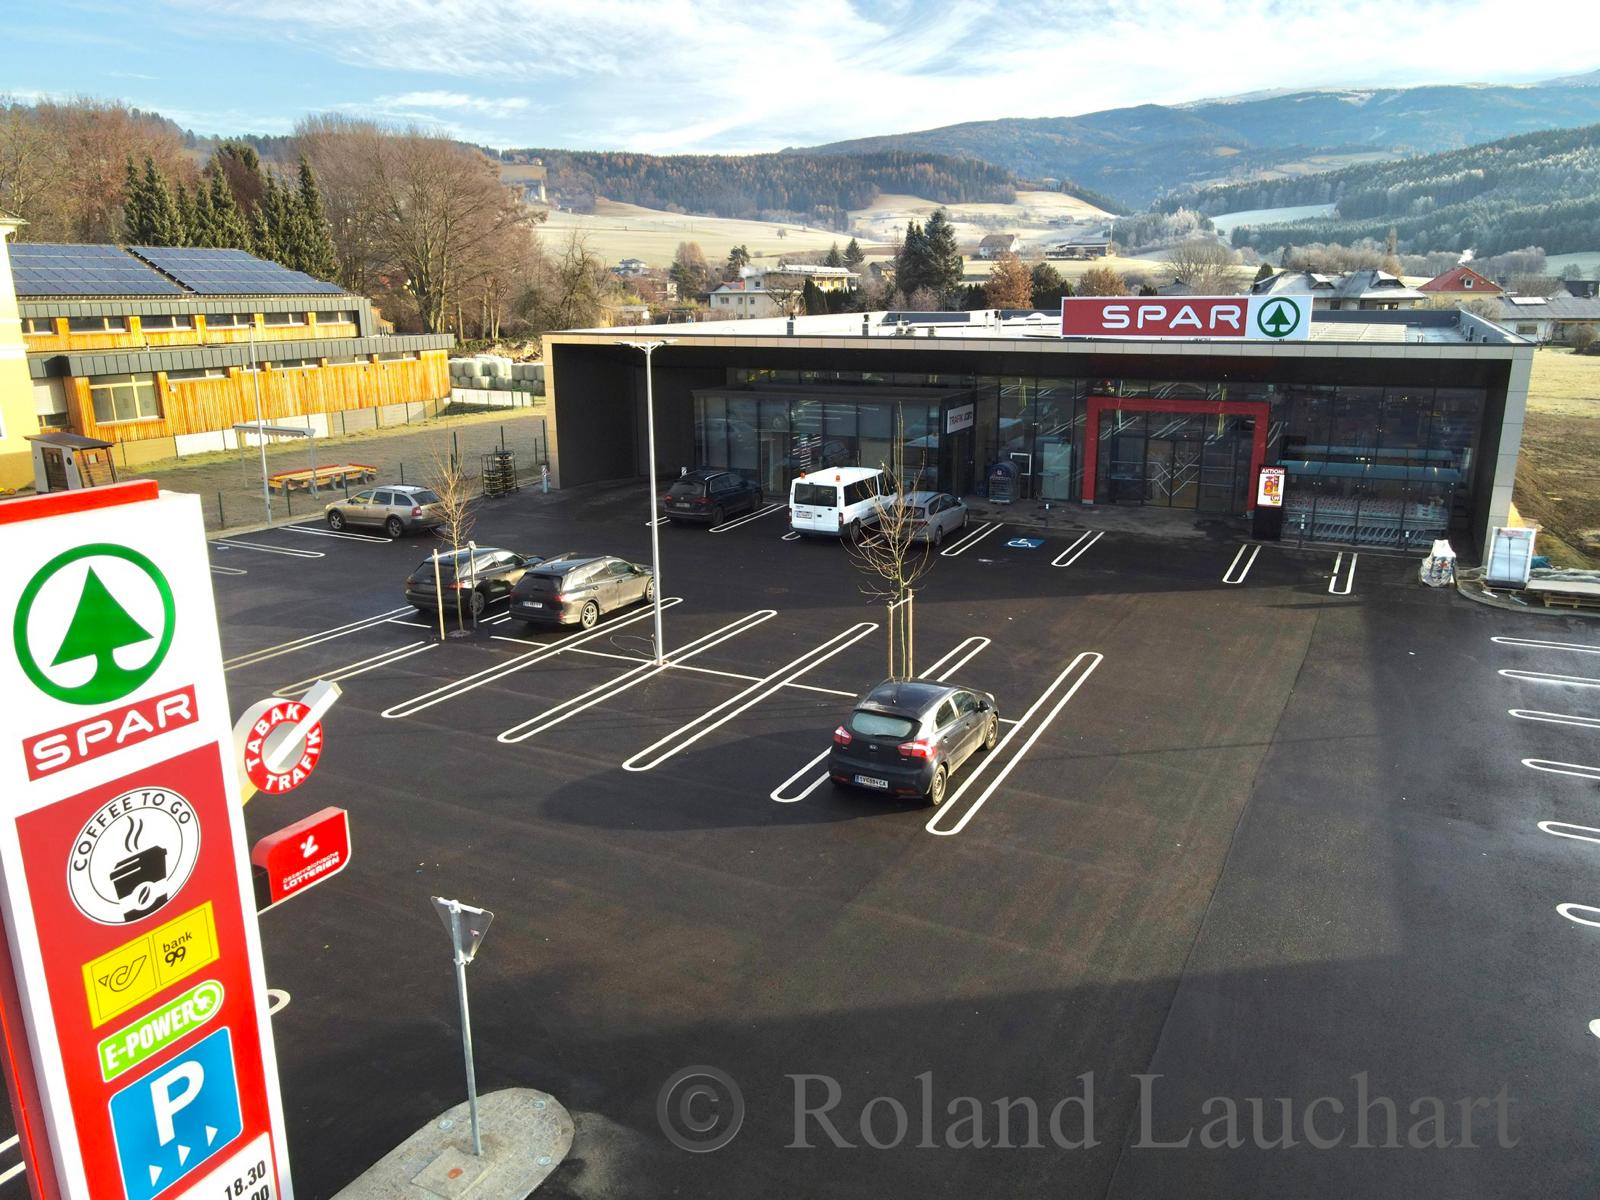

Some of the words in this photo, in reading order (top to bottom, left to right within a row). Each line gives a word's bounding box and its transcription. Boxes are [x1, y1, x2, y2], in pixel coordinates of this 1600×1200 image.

[1101, 304, 1242, 330] SPAR
[32, 691, 192, 772] SPAR
[246, 702, 304, 772] TABAK
[265, 727, 322, 792] TRAFIK
[73, 796, 133, 872] COFFEE
[142, 791, 166, 807] TO
[170, 800, 192, 826] GO
[283, 856, 340, 891] LOTTERIEN
[162, 930, 193, 954] bank
[164, 945, 187, 968] 99
[105, 997, 196, 1070] E-POWER
[149, 1060, 205, 1147] P
[224, 1159, 266, 1200] 18.30
